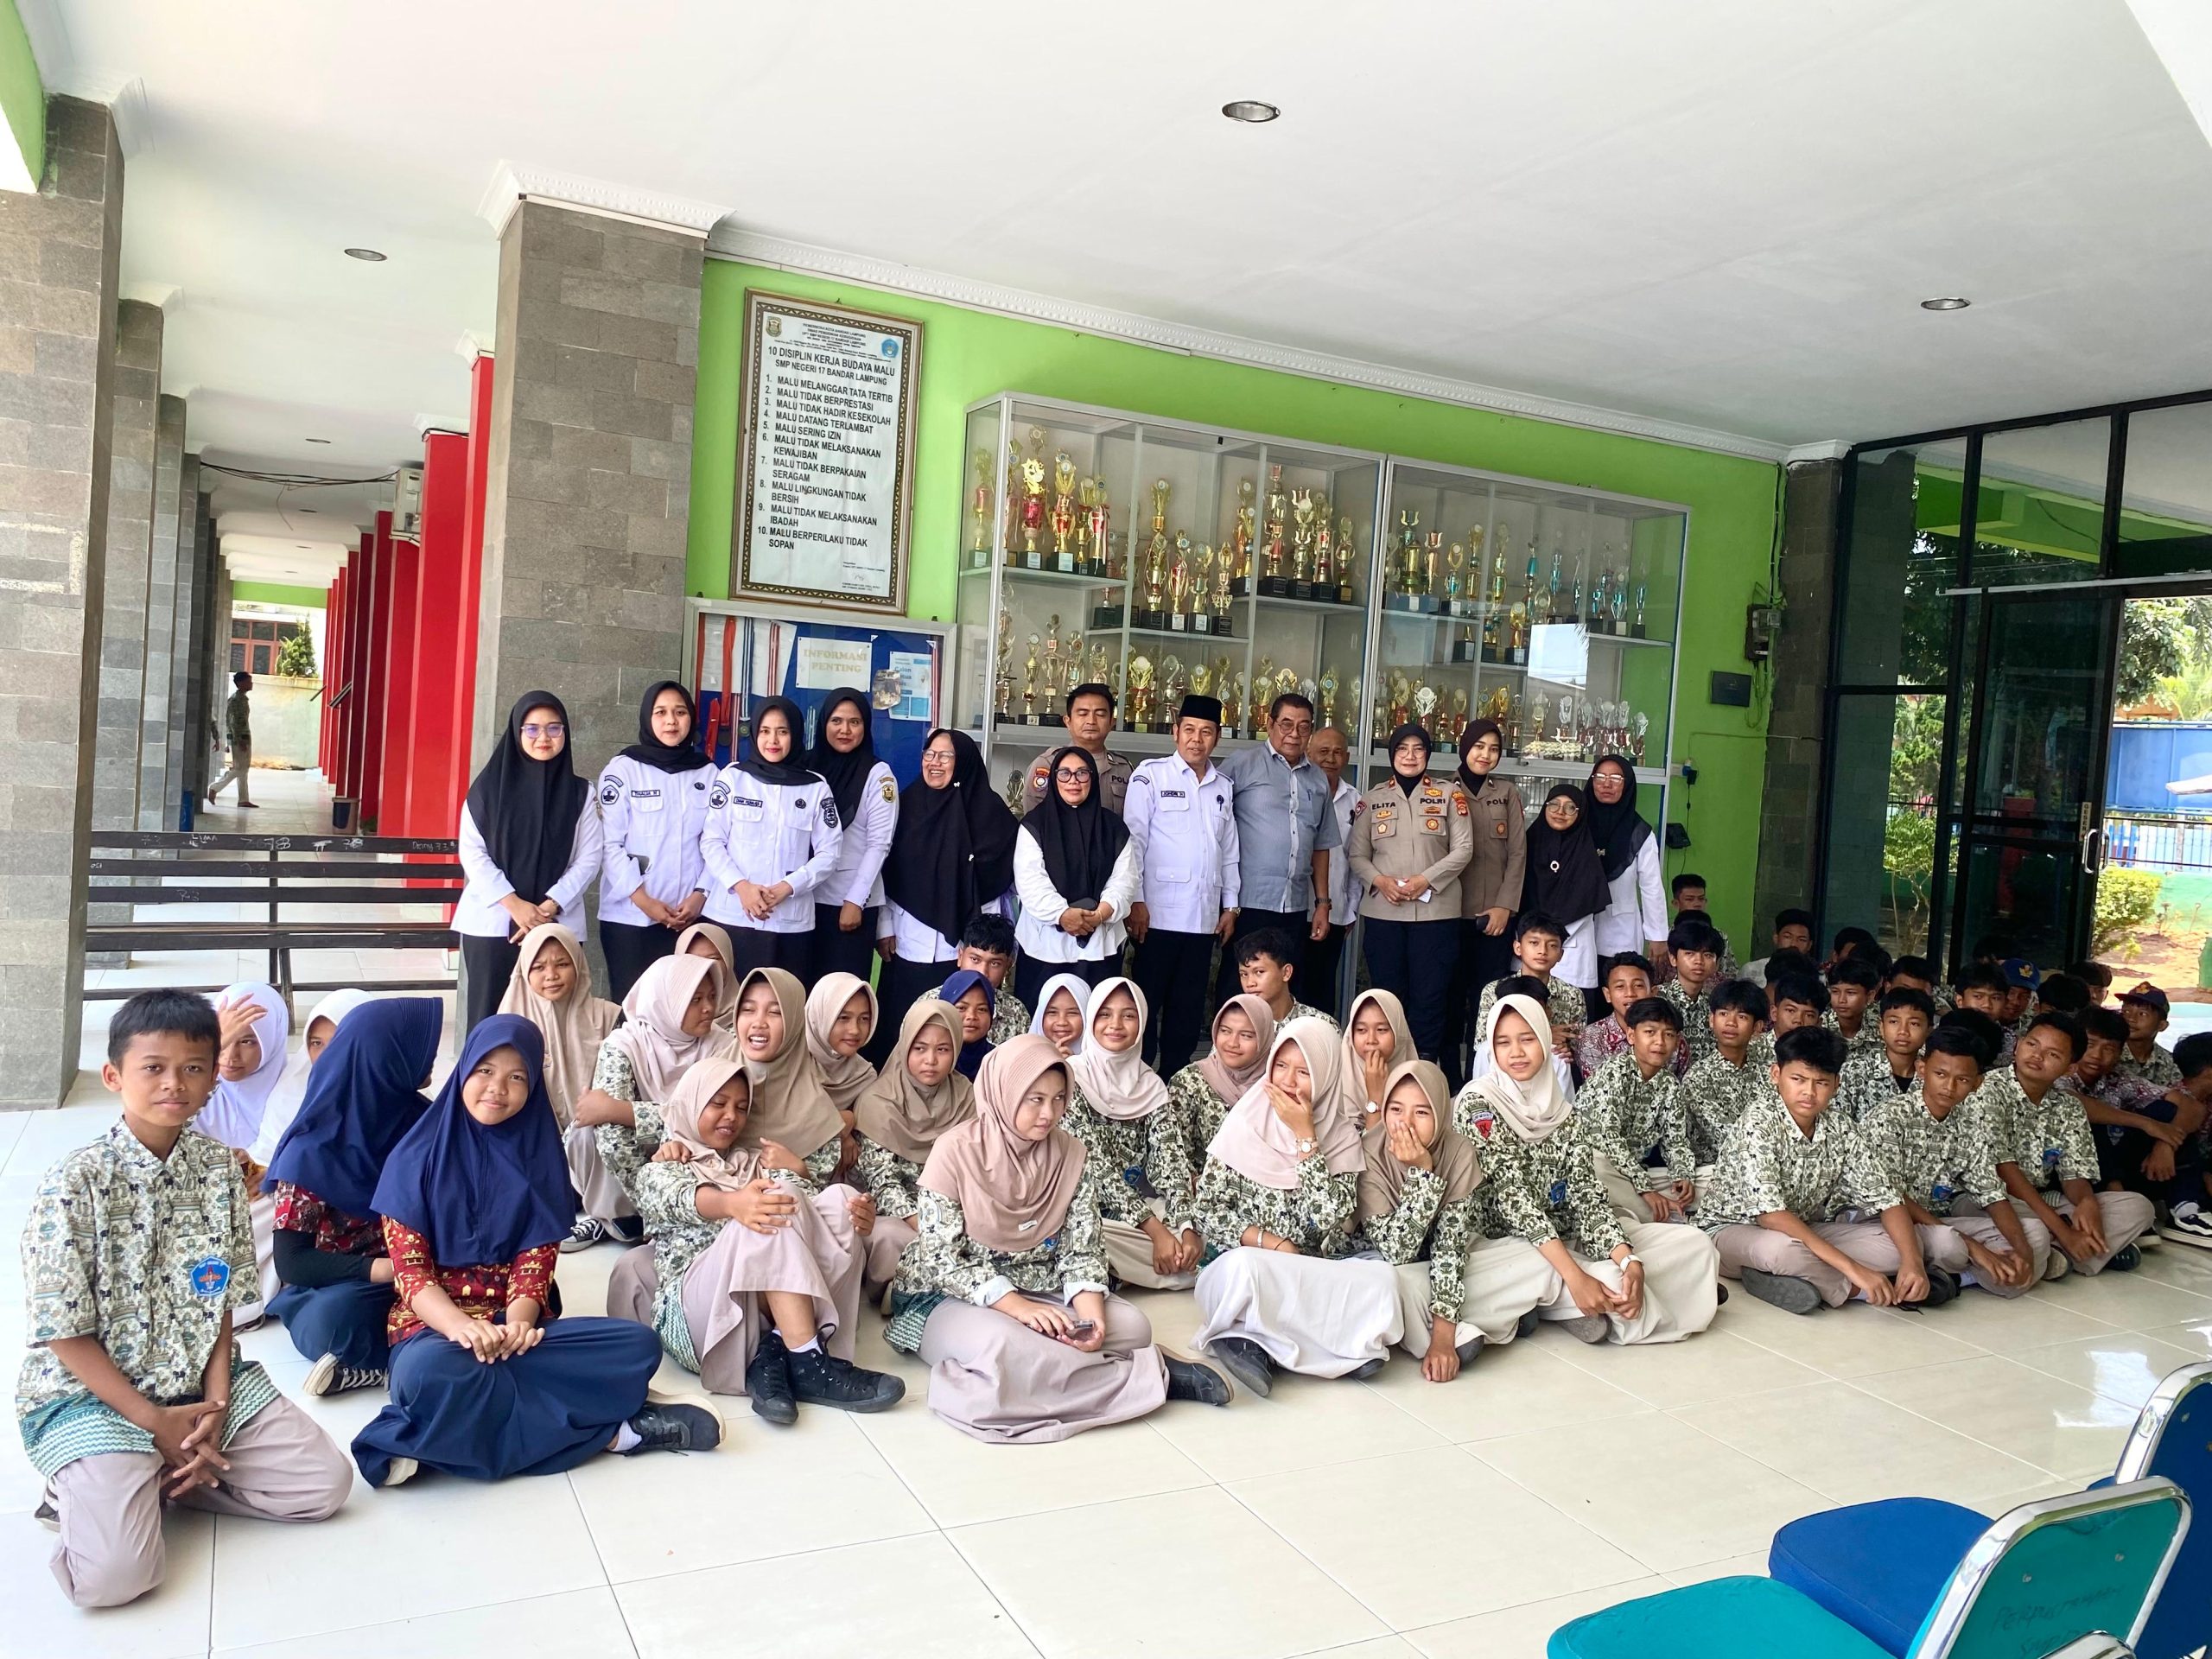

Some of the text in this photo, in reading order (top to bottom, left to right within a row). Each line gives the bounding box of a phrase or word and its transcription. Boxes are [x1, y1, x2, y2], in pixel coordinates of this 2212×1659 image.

[768, 346, 778, 355] 10
[779, 347, 812, 361] DISIPLIN
[814, 353, 841, 366] KERJA
[842, 359, 873, 372] BUDAYA
[874, 364, 895, 377] MALU
[775, 359, 791, 368] SMP
[791, 362, 817, 373] NEGERI
[826, 367, 855, 380] BANDAR
[855, 373, 887, 385] LAMPUNG
[765, 385, 874, 411] 2. MALU TIDAK BERPRESTASI
[766, 373, 893, 403] 1. MALU MELANGGAR TATA TERTIB
[764, 409, 874, 434] 4. MALU DATANG TERLAMBAT
[765, 397, 891, 426] 3. MALU TIDAK HADIR KESEKOLAH
[763, 421, 842, 441] 5. MALU SERING IZIN
[762, 432, 881, 458] 6. MALU TIDAK MELAKSANAKAN
[773, 446, 817, 461] KEWAJIBAN
[761, 455, 867, 479] 7. MALU TIDAK BERPAKAIAN
[772, 469, 810, 482] SERAGAM
[760, 479, 867, 502] 8. MALU LINGKUNGAN TIDAK
[771, 493, 799, 504] BERSIH
[759, 502, 877, 526] 9. MALU TIDAK MELAKSANAKAN
[770, 515, 798, 527] IBADAH
[758, 525, 868, 547] 10. MALU BERPERILAKU TIDAK
[768, 538, 795, 550] SOPAN
[804, 649, 868, 661] INFORMASI
[812, 662, 861, 673] PENTING
[1111, 775, 1128, 785] POL
[1486, 798, 1508, 806] POLR
